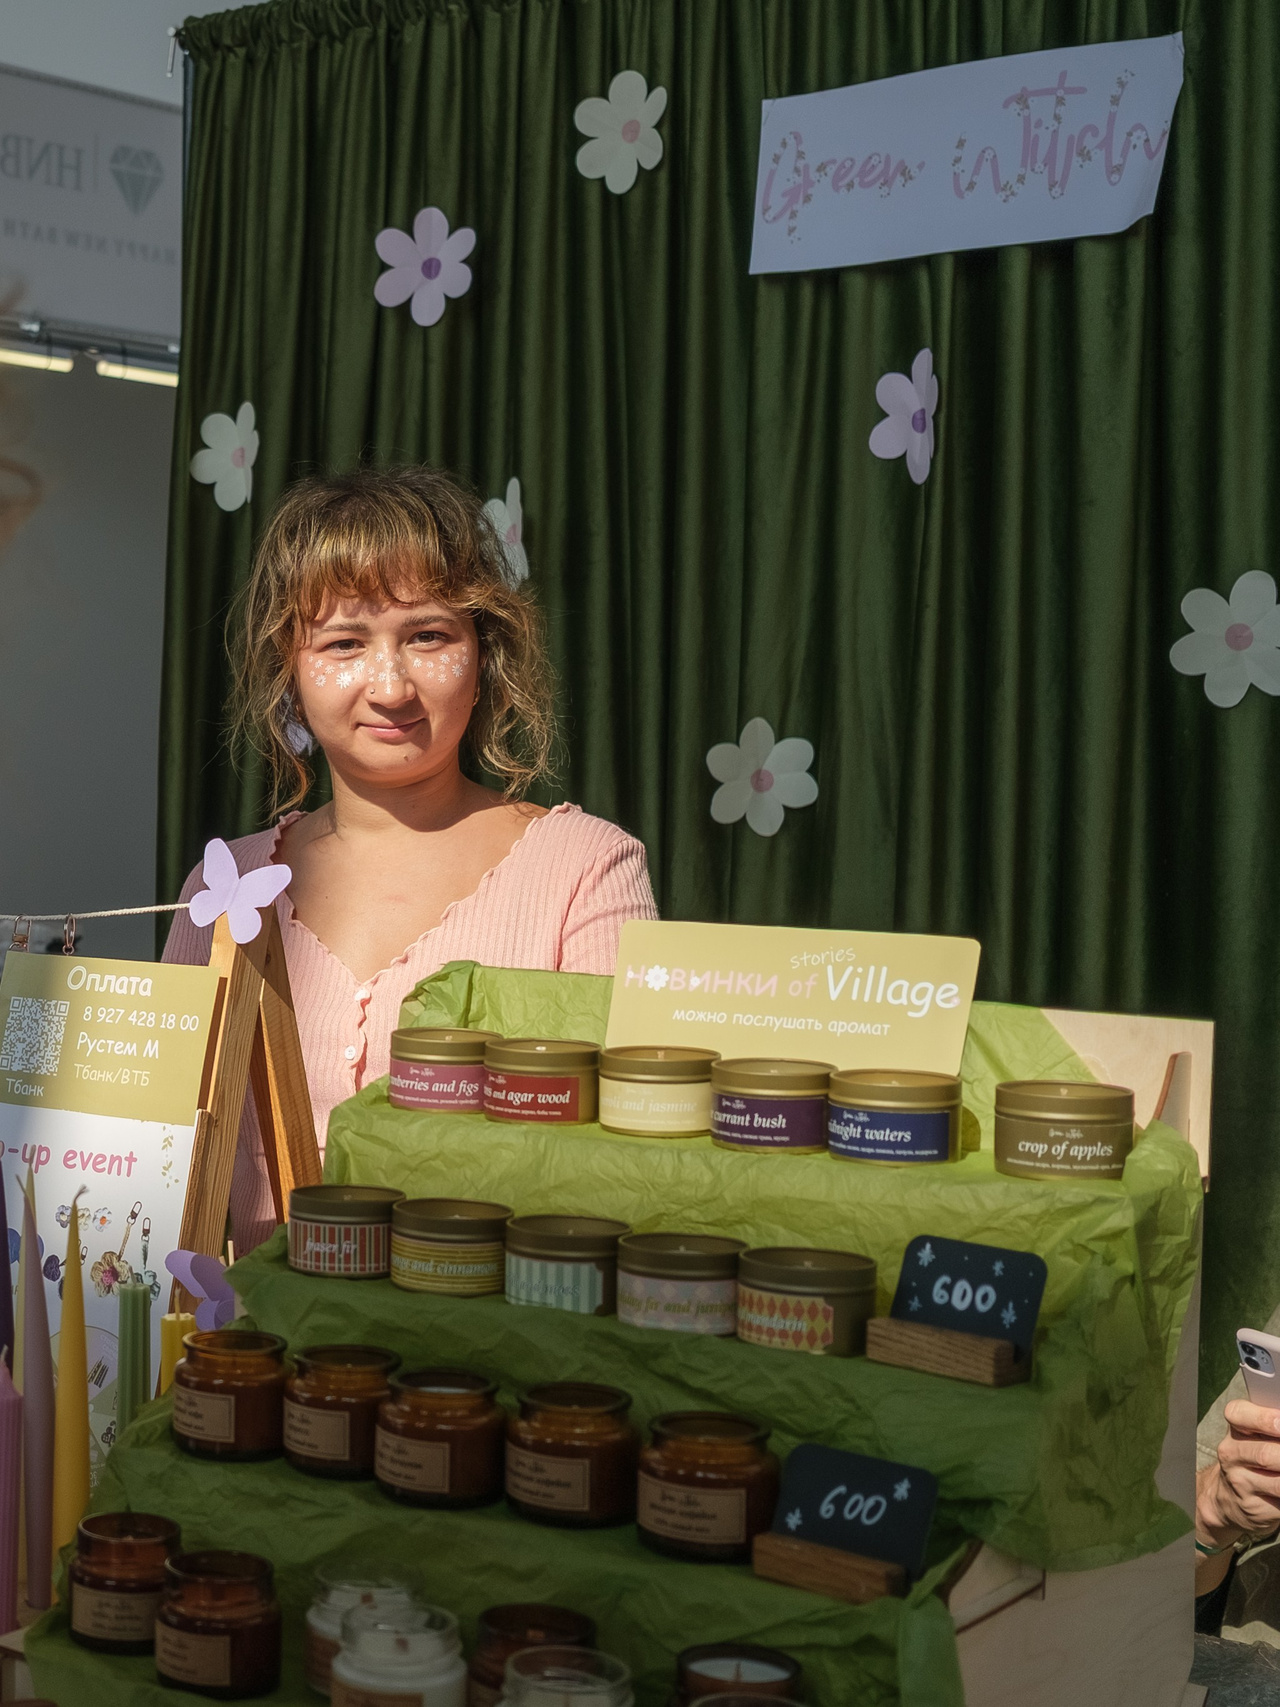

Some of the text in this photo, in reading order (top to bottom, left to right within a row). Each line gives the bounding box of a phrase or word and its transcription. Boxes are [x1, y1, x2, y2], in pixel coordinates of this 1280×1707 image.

[761, 131, 925, 243] Green
[790, 946, 856, 969] stories
[66, 965, 153, 997] Оплата
[788, 973, 819, 999] of
[827, 965, 960, 1018] Village
[83, 1006, 200, 1031] 8 927 428 18 00
[672, 1009, 891, 1037] можно послушать аромат
[76, 1032, 137, 1057] Рустем
[6, 1078, 45, 1097] Тбанк
[432, 1079, 456, 1093] and
[456, 1080, 480, 1097] figs
[507, 1091, 535, 1106] agar
[537, 1090, 571, 1105] wood
[646, 1098, 697, 1114] jasmine
[753, 1112, 787, 1129] bush
[864, 1126, 912, 1143] waters
[1018, 1138, 1114, 1162] crop of apples
[63, 1150, 138, 1177] event
[932, 1274, 997, 1313] 600
[819, 1484, 888, 1526] 600
